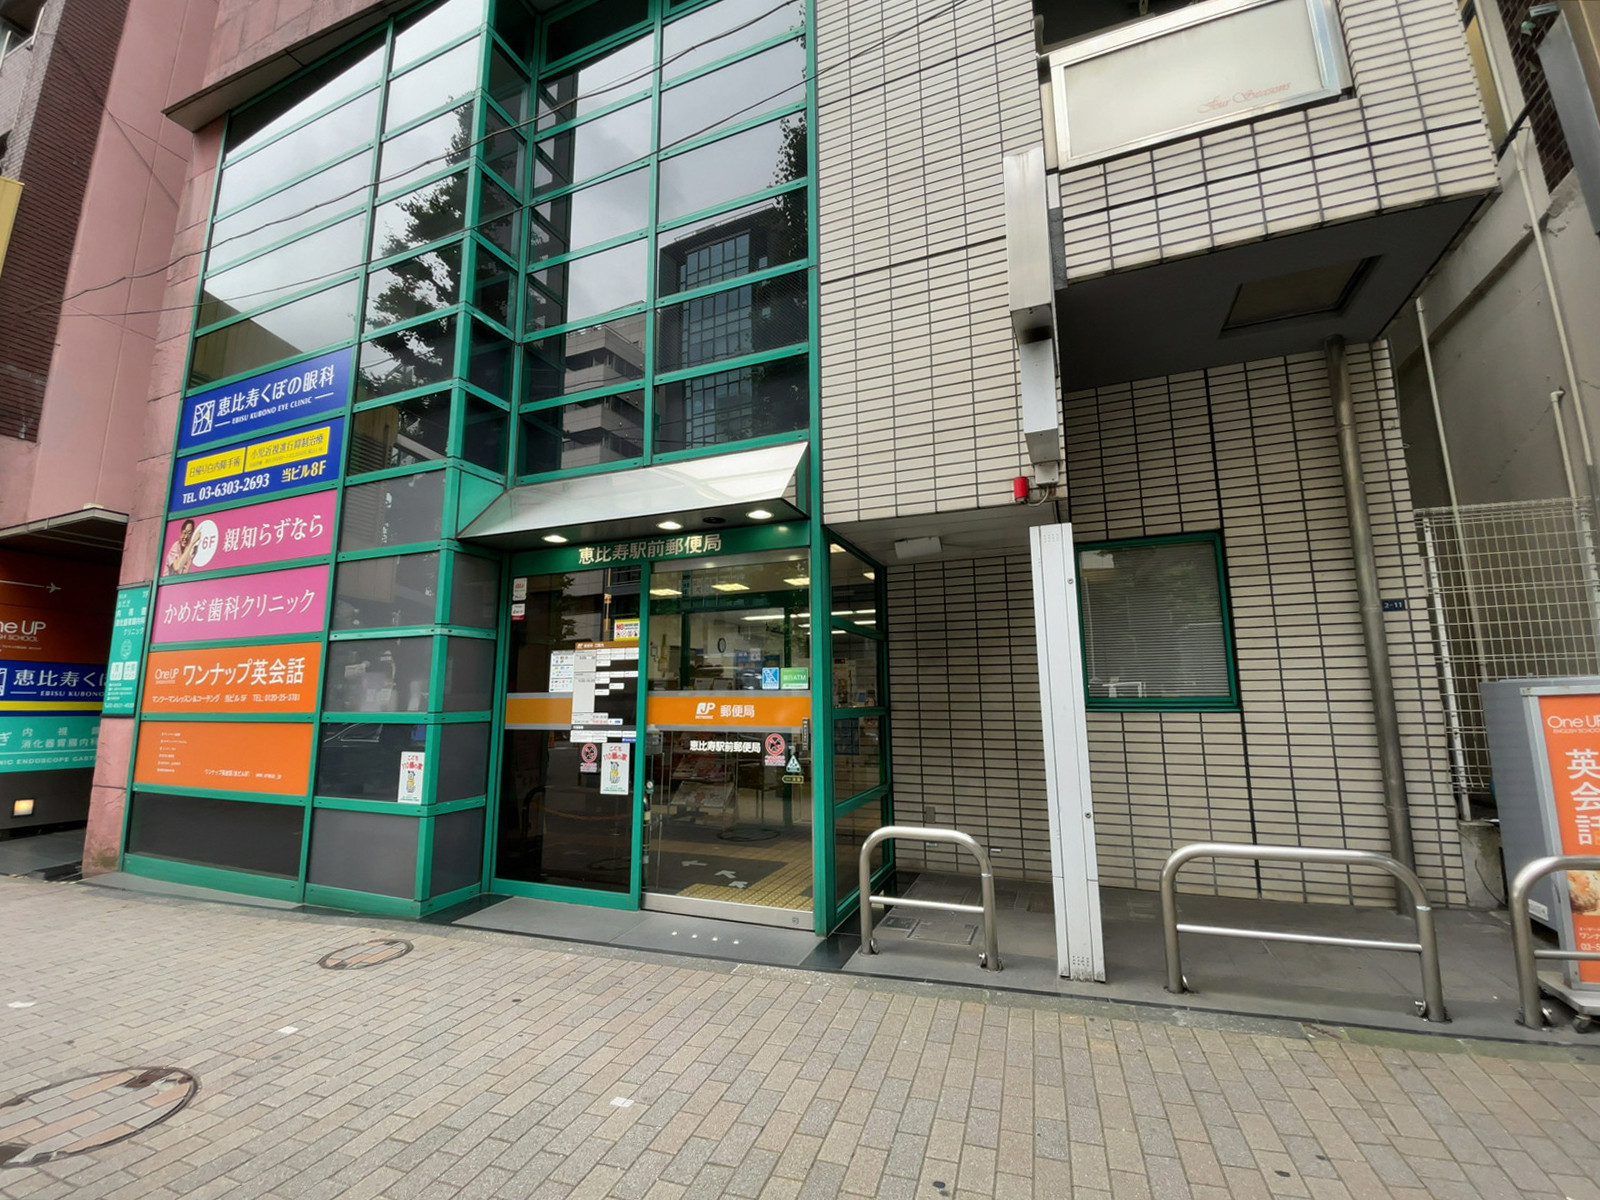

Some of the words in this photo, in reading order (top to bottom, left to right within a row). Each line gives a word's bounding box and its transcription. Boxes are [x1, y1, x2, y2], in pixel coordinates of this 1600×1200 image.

[217, 364, 335, 417] 恵比寿くぼの眼科
[278, 403, 288, 413] EYE
[290, 396, 312, 408] CLINIC
[199, 474, 270, 501] 03-6303-2693
[281, 460, 327, 483] 当ビル8F
[202, 535, 216, 549] 6F
[222, 514, 324, 552] 親知らずなら
[579, 533, 721, 565] 恵比寿駅前郵便局
[164, 589, 315, 625] かめだ歯科クリニック
[21, 620, 46, 635] UP
[183, 657, 306, 686] ワンナップ英会話
[720, 704, 755, 718] 郵便局
[690, 740, 761, 753] 恵比寿駅前郵便局
